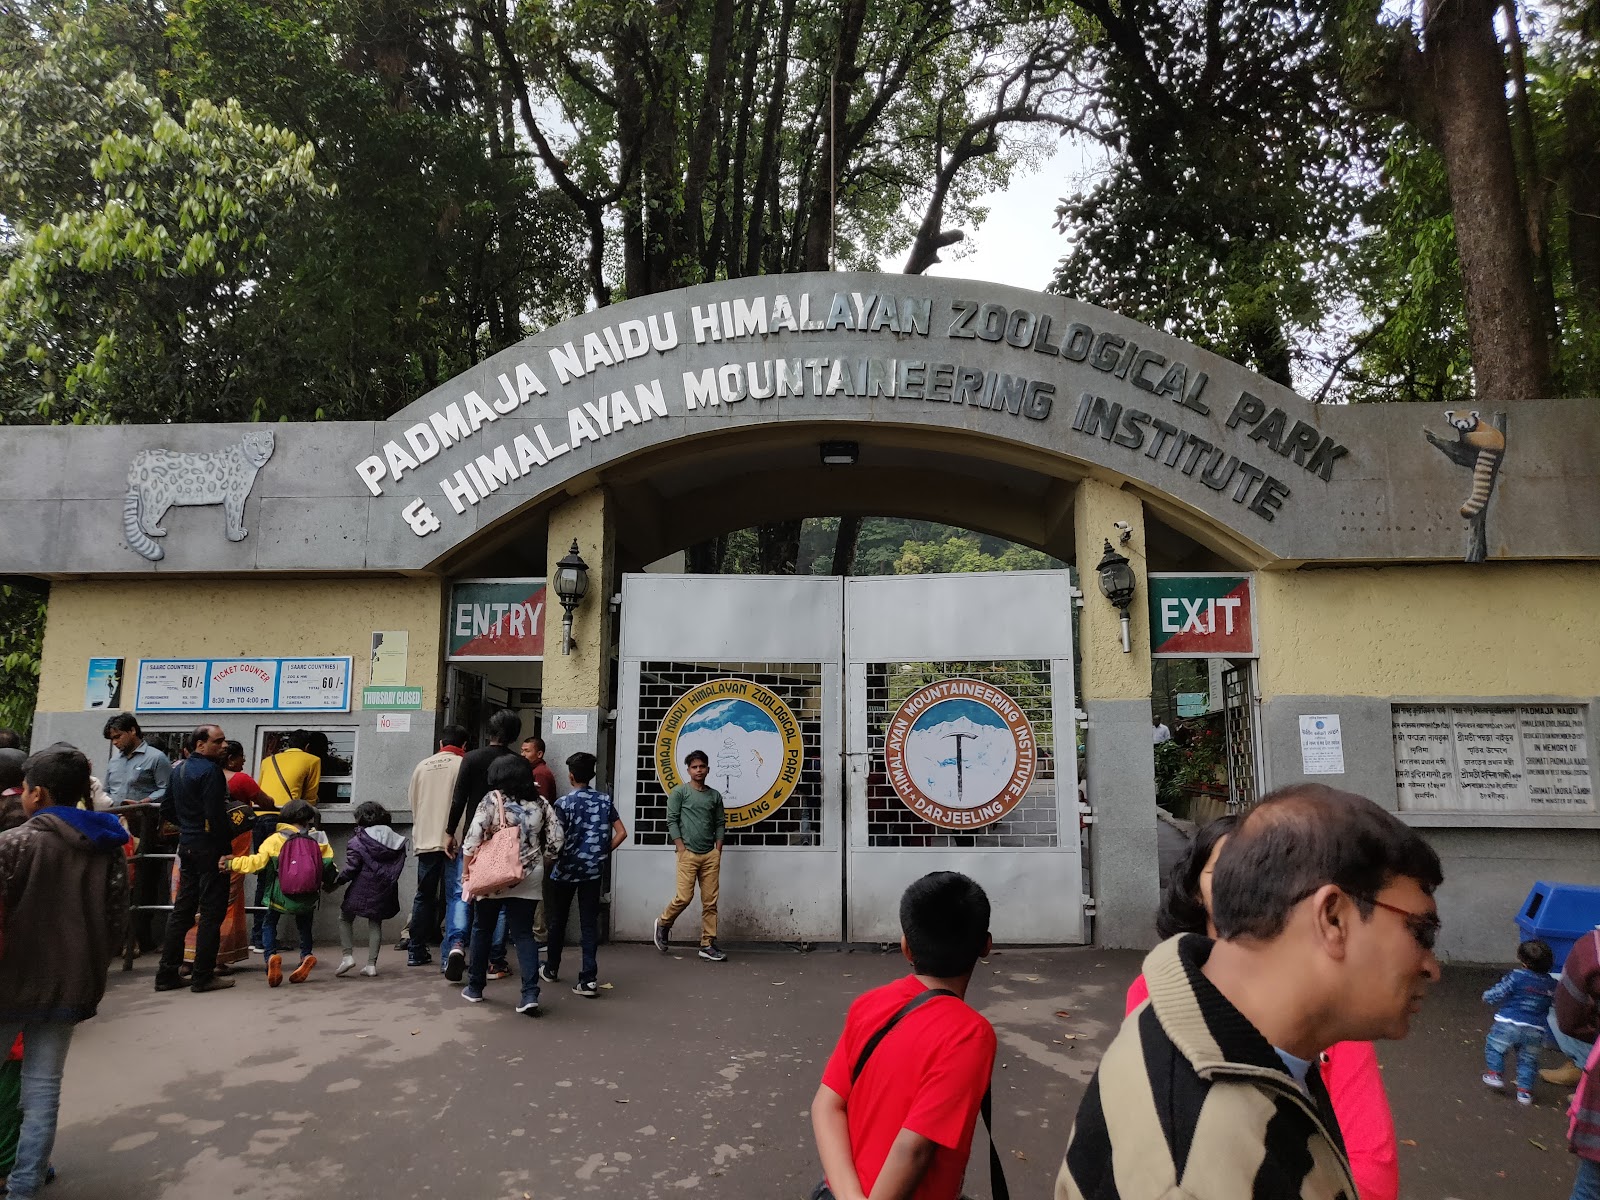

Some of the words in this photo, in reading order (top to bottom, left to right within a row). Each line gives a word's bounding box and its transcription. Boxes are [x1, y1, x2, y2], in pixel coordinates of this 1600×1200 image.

[355, 363, 548, 497] PADMAJA
[548, 310, 678, 385] NAIDU
[691, 292, 932, 343] HIMALAYAN
[948, 299, 1210, 416] ZOOLOGICAL
[1225, 390, 1350, 482] PARK
[401, 497, 441, 537] &
[439, 378, 668, 514] HIMALAYAN
[683, 357, 1056, 420] MOUNTAINEERING
[1072, 392, 1291, 522] INSTITUTE
[455, 602, 544, 637] ENTRY
[1160, 597, 1241, 635] EXIT
[213, 665, 238, 683] TICKET
[240, 664, 271, 683] COUNTER
[364, 691, 396, 704] THURSDAY
[397, 691, 420, 704] CLOSED
[688, 683, 748, 706] HIMALAYAN
[380, 719, 391, 728] NO
[556, 721, 567, 730] NO
[665, 704, 688, 733] NAIDU
[751, 687, 797, 744] ZOOLOGICAL
[889, 718, 913, 796] HIMALAYAN
[904, 682, 1019, 722] MOUNTAINEERING
[1008, 725, 1032, 796] INSTITUTE
[1543, 744, 1568, 752] MEMORY
[1570, 744, 1577, 752] OF
[660, 737, 678, 790] PADMAJA
[781, 750, 798, 783] PARK
[1529, 785, 1553, 794] SHRIMATI
[1553, 785, 1572, 794] INDIRA
[724, 800, 770, 823] EELING
[914, 798, 1003, 824] DARJEELING
